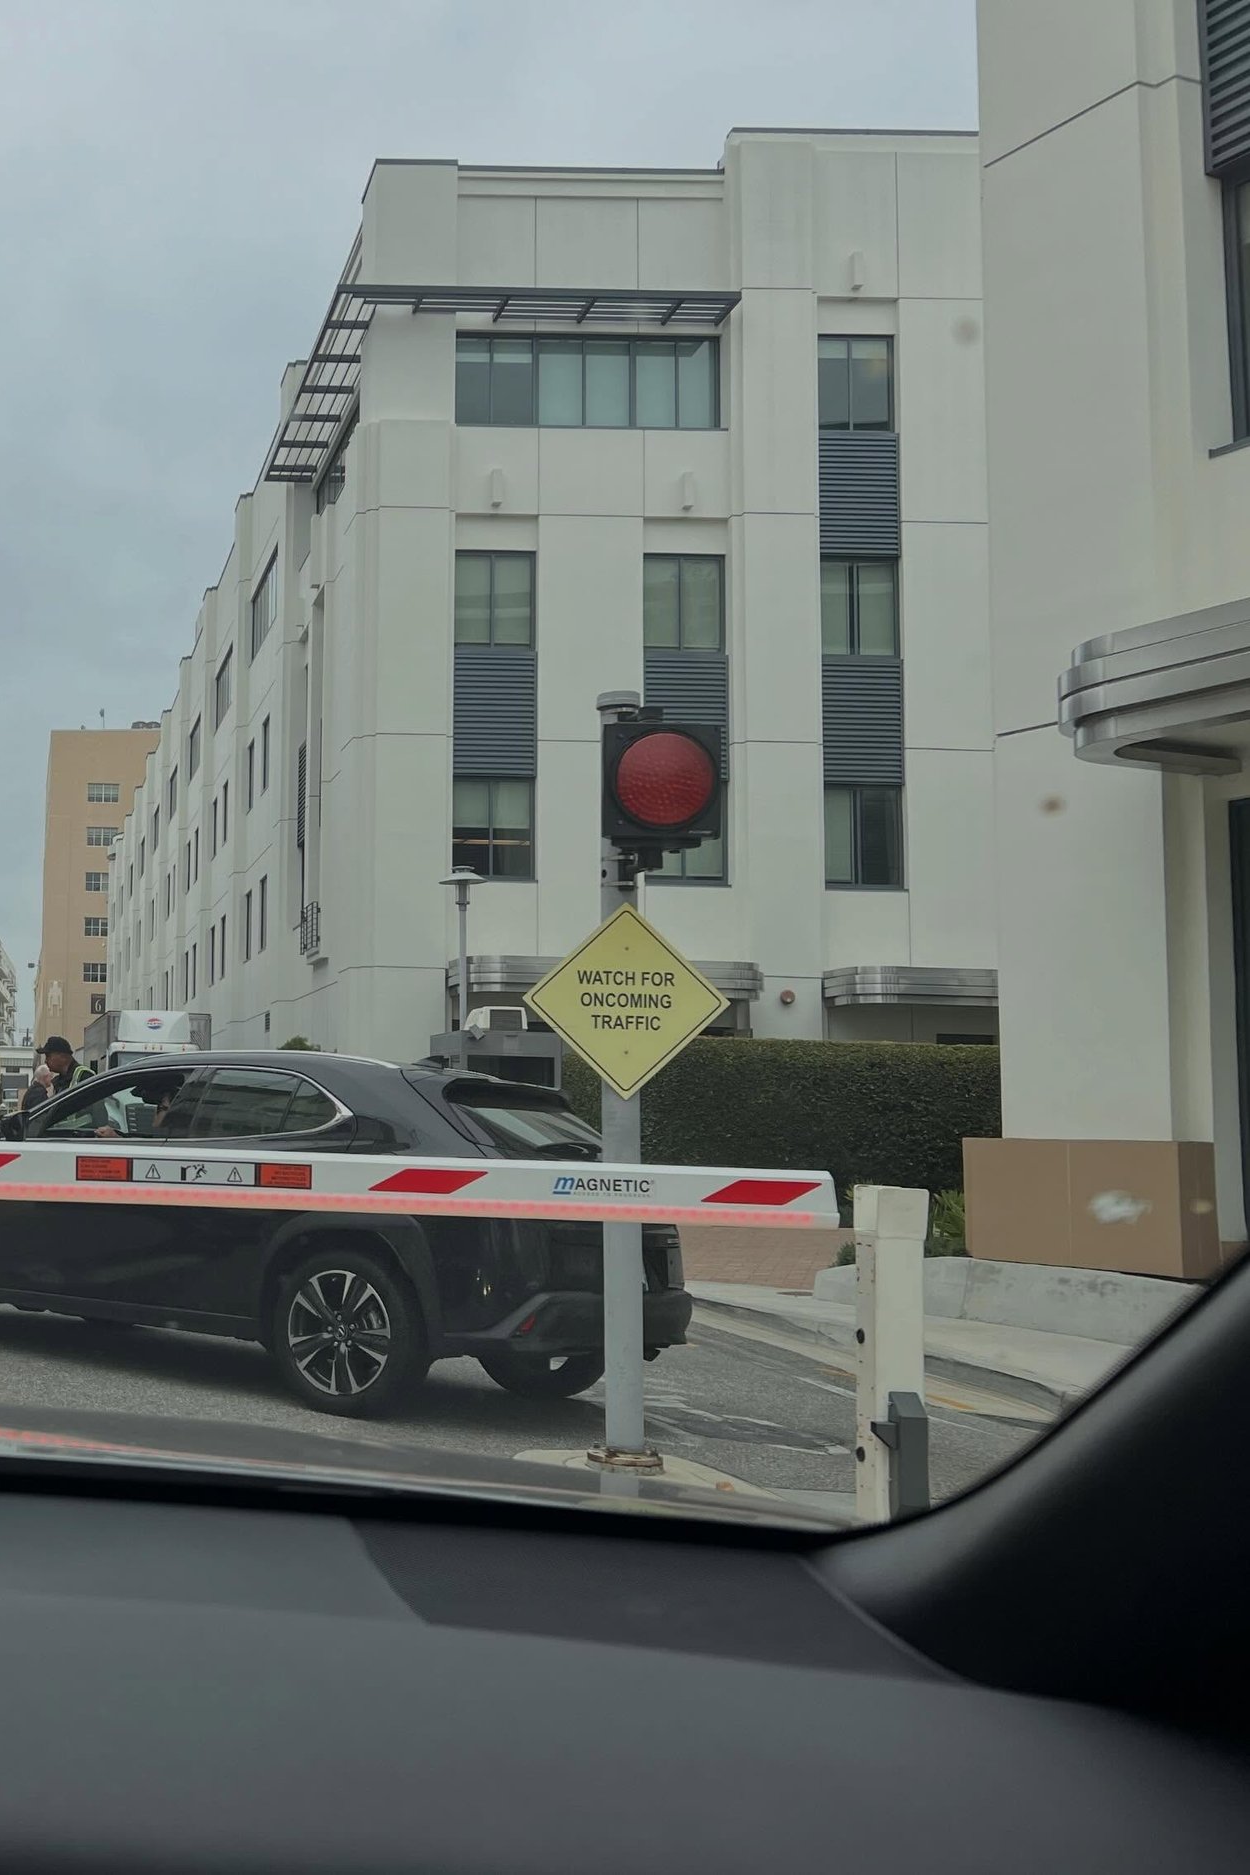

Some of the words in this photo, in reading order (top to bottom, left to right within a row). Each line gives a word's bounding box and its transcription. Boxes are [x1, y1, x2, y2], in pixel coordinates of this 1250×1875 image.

[577, 970, 636, 986] WATCH
[641, 972, 675, 987] FOR
[95, 998, 102, 1012] 6
[580, 992, 672, 1009] ONCOMING
[591, 1014, 661, 1031] TRAFFIC
